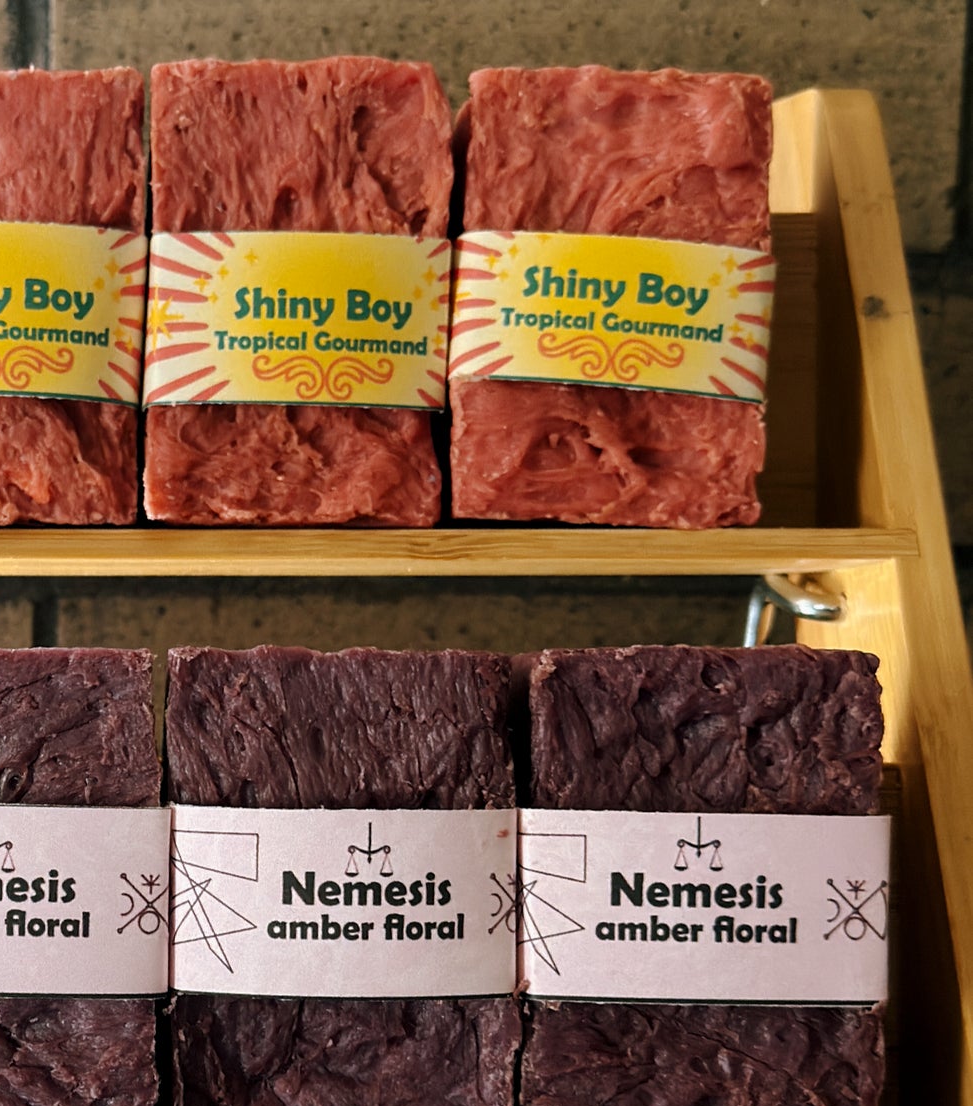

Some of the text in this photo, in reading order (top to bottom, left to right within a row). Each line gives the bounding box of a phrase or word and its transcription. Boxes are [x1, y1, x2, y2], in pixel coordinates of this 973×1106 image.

[24, 277, 95, 321] Boy
[234, 286, 413, 331] Shiny Boy
[522, 265, 710, 317] Shiny Boy
[214, 330, 429, 357] Tropical Gourmand
[500, 307, 725, 344] Tropical Gourmand
[281, 866, 452, 907] Nemesis
[610, 871, 784, 910] Nemesis
[4, 908, 91, 939] floral
[267, 912, 465, 941] amber floral
[595, 914, 798, 944] amber floral
